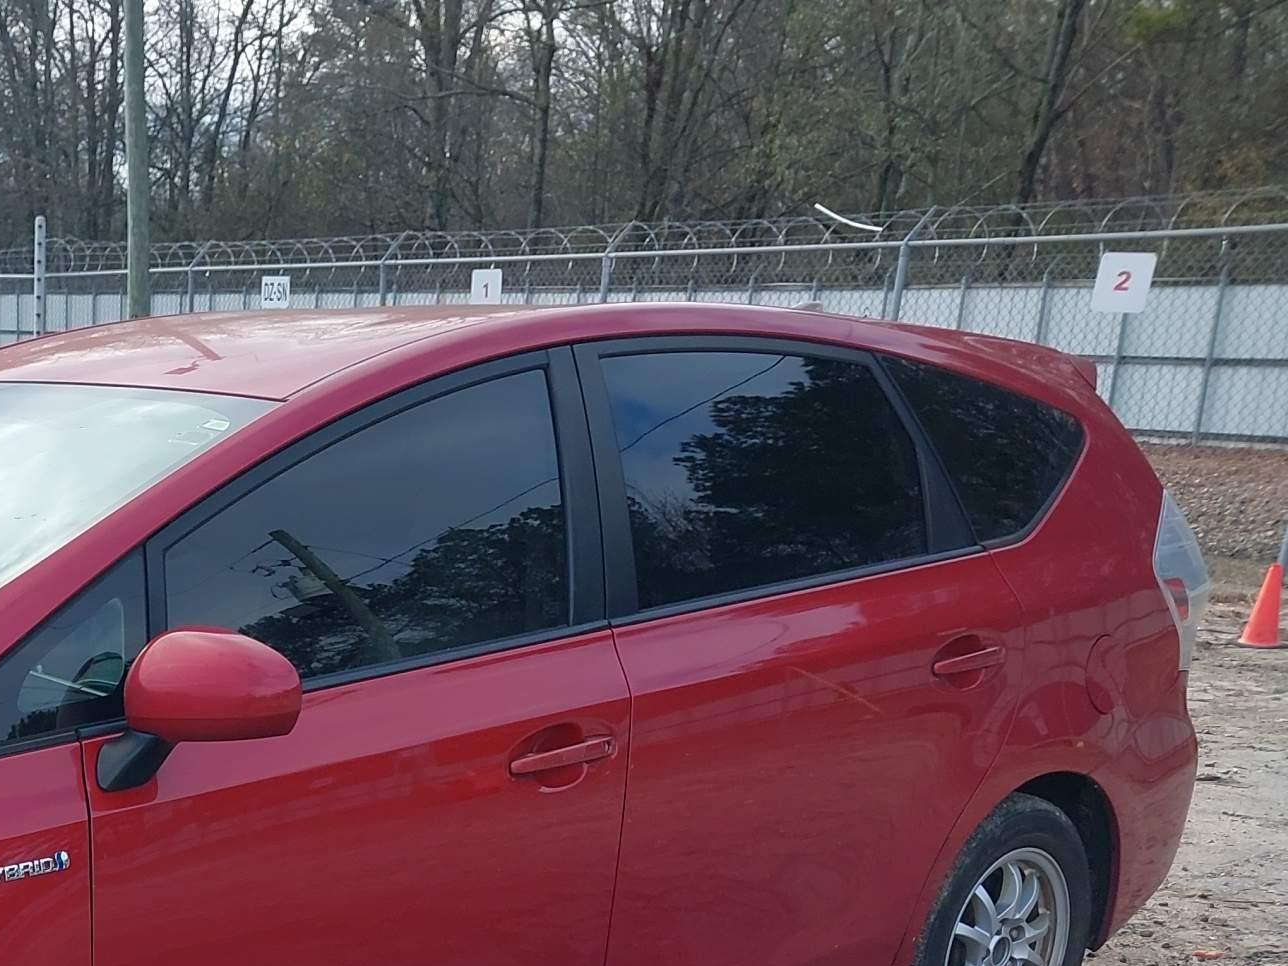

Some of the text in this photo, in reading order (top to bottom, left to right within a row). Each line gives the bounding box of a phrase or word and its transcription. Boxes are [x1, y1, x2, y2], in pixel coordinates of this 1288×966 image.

[482, 282, 489, 298] 1
[1113, 271, 1132, 291] 2
[264, 282, 288, 302] DZ-SN
